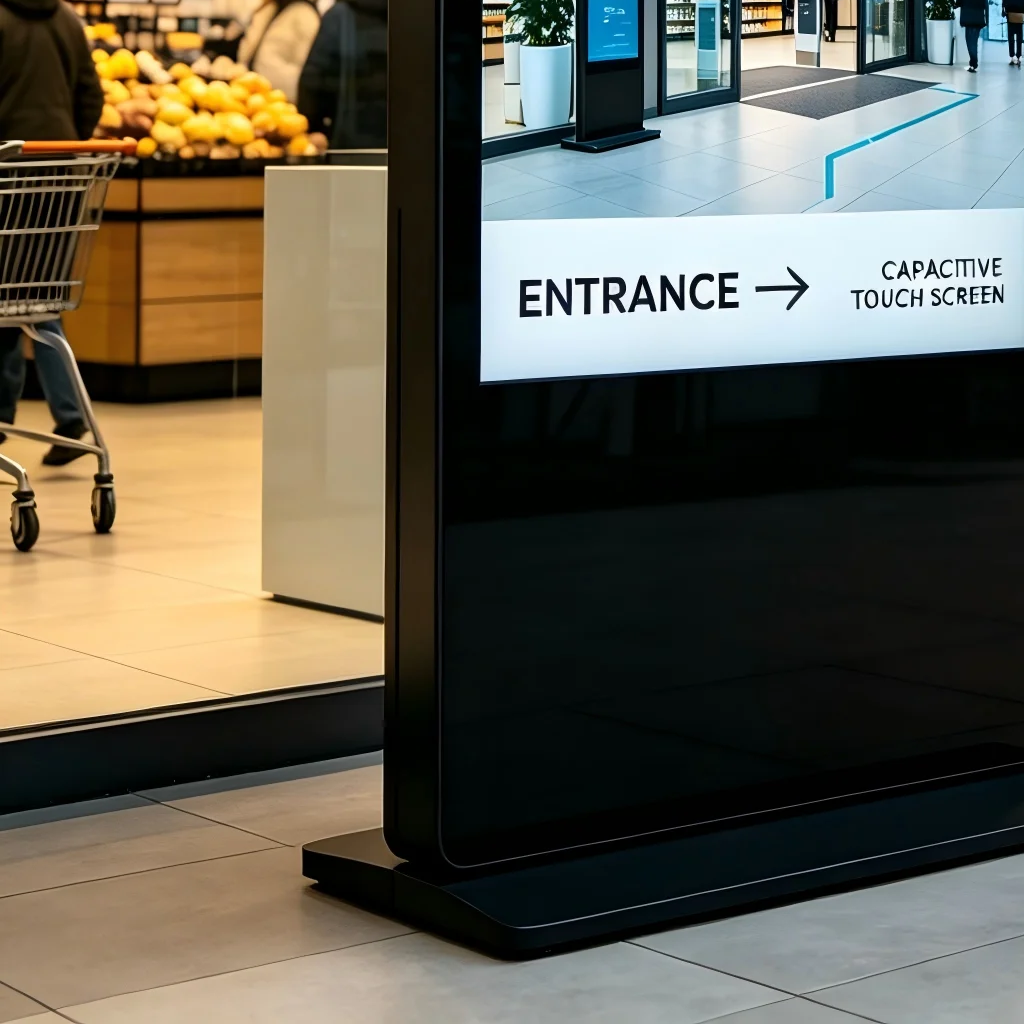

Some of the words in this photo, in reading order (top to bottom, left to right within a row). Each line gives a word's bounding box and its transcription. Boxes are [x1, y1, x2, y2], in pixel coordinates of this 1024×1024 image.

[519, 272, 740, 318] ENTRANCE
[850, 288, 924, 310] TOUCH
[930, 283, 1004, 307] SCREEN
